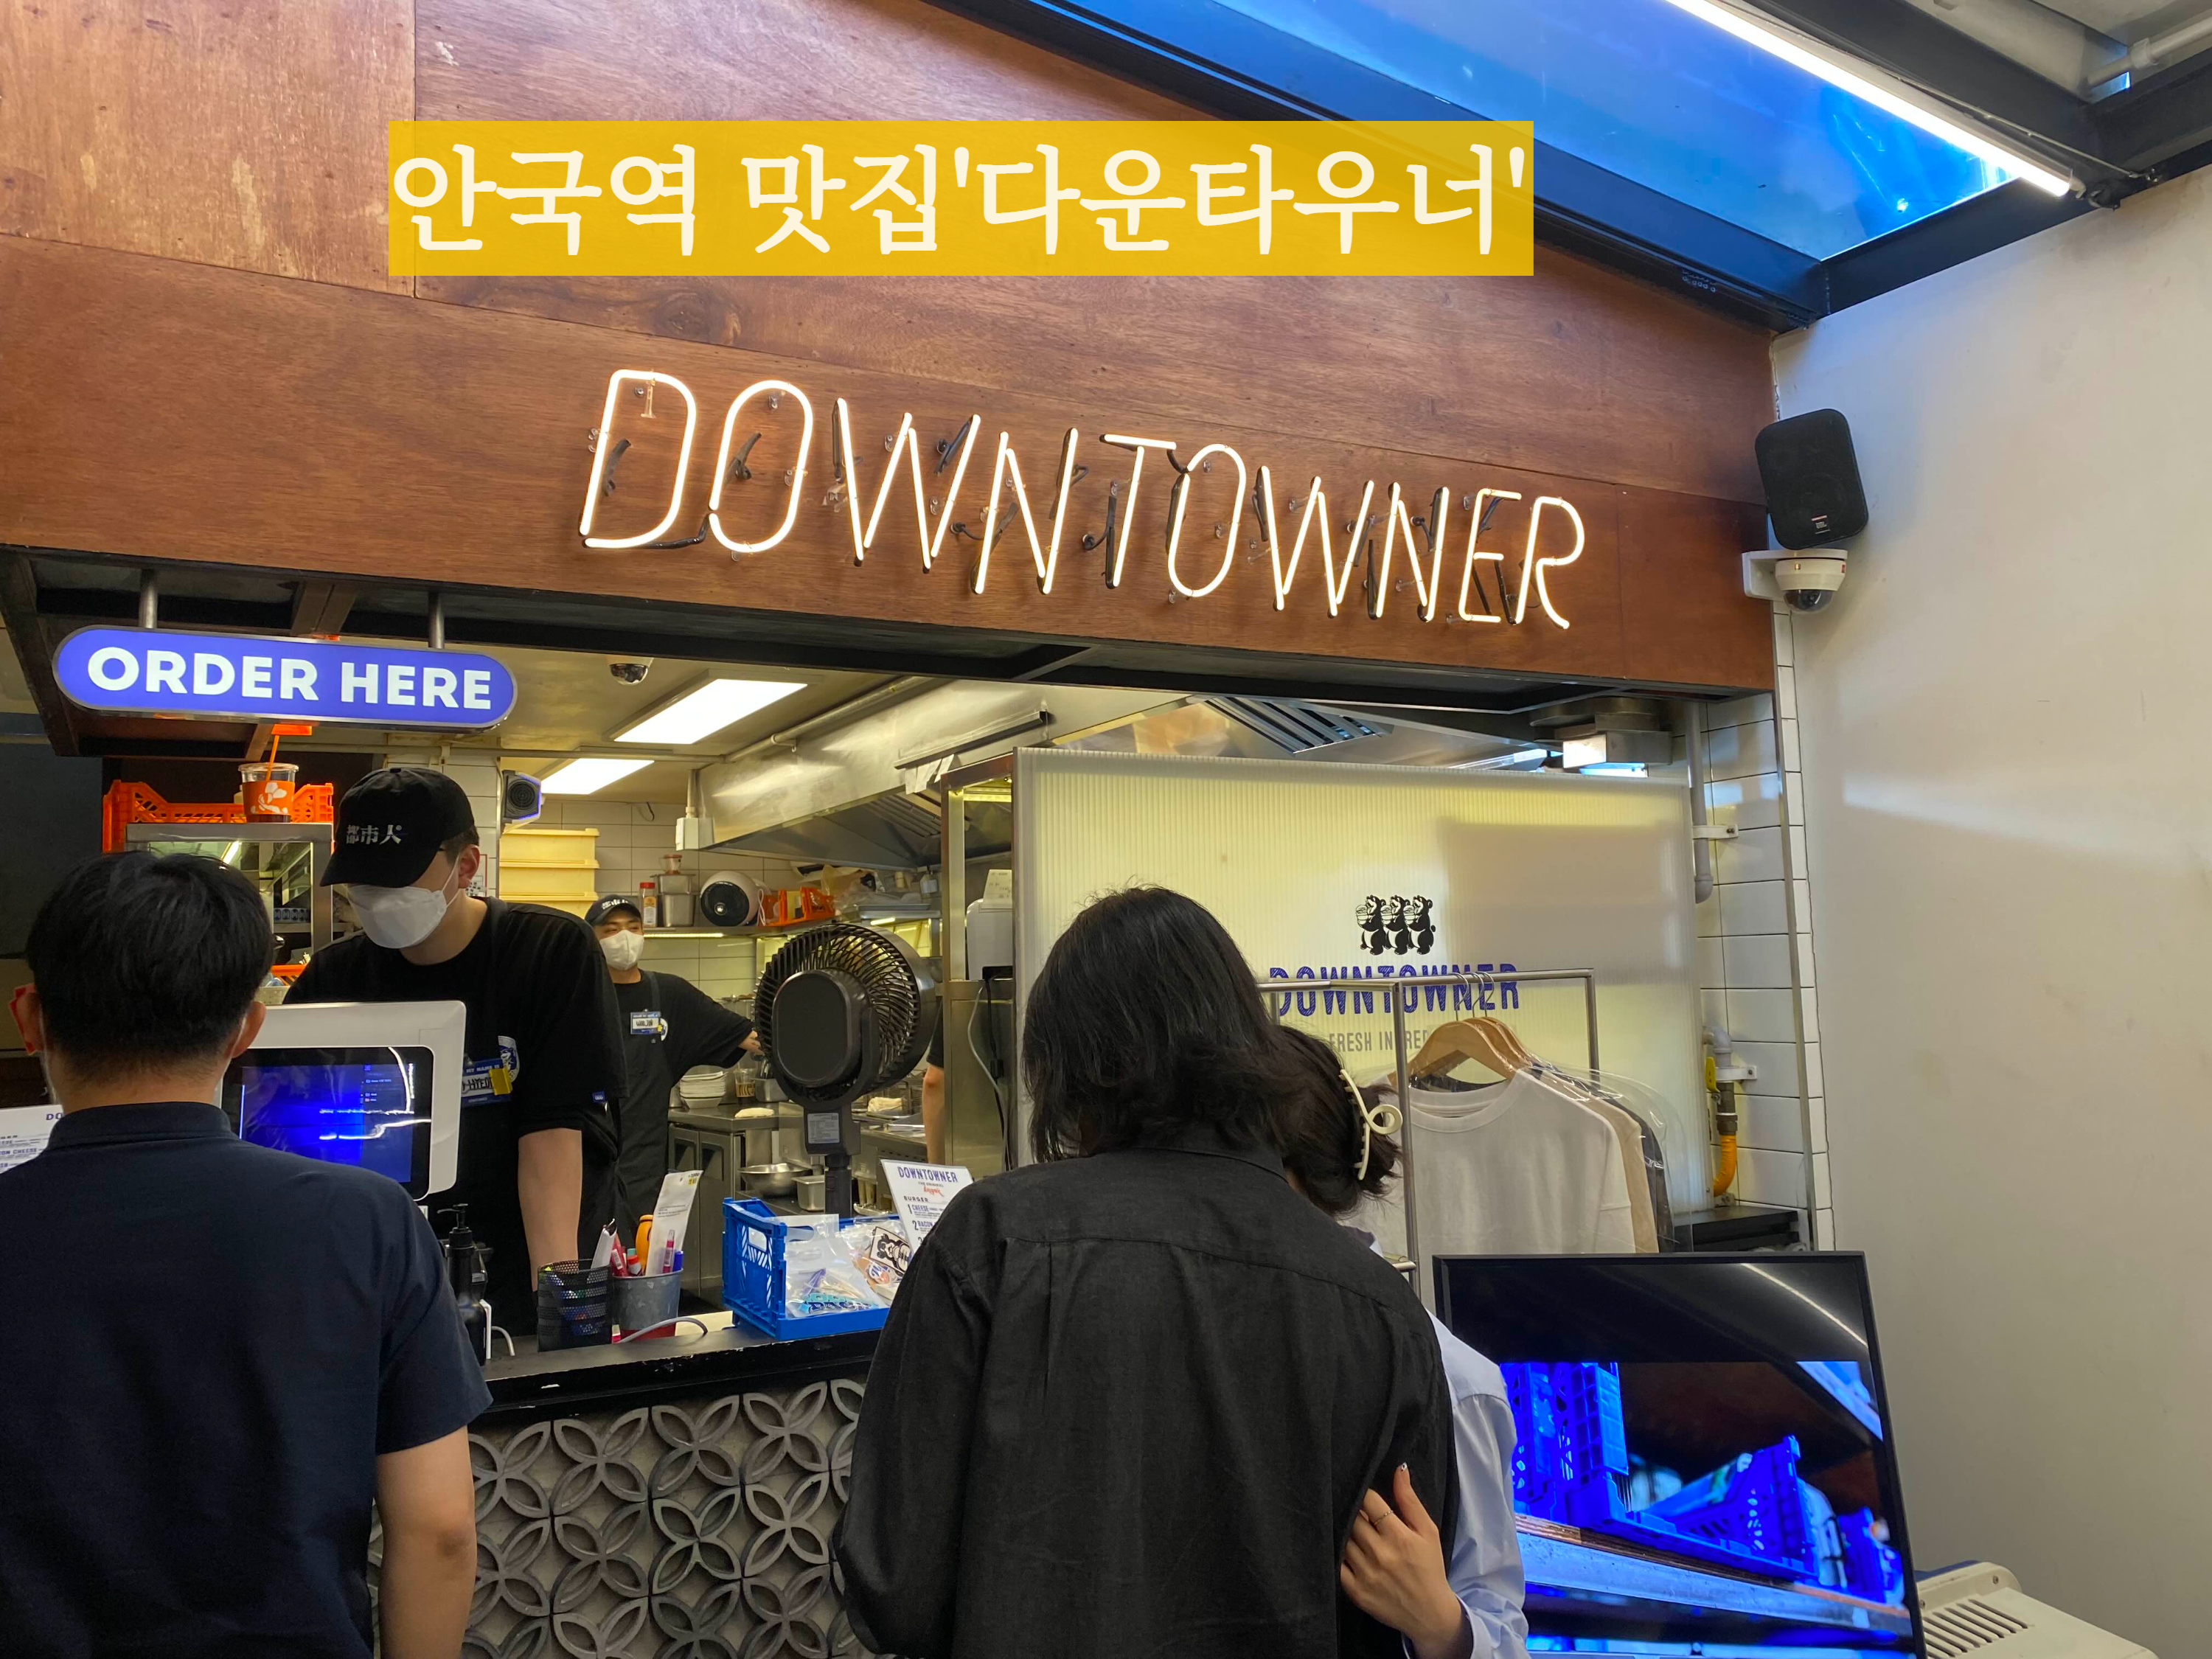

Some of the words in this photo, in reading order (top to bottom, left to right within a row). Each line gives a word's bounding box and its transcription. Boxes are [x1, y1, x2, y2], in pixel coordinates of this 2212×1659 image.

[579, 369, 1586, 630] DOWNTOWNER
[87, 646, 319, 701] ORDER
[340, 661, 492, 710] HERE
[1270, 964, 1520, 1017] DOWNTOWNER
[1329, 1032, 1372, 1053] FRESH
[897, 1166, 958, 1183] DOWNTOWNER
[912, 1220, 919, 1231] 2
